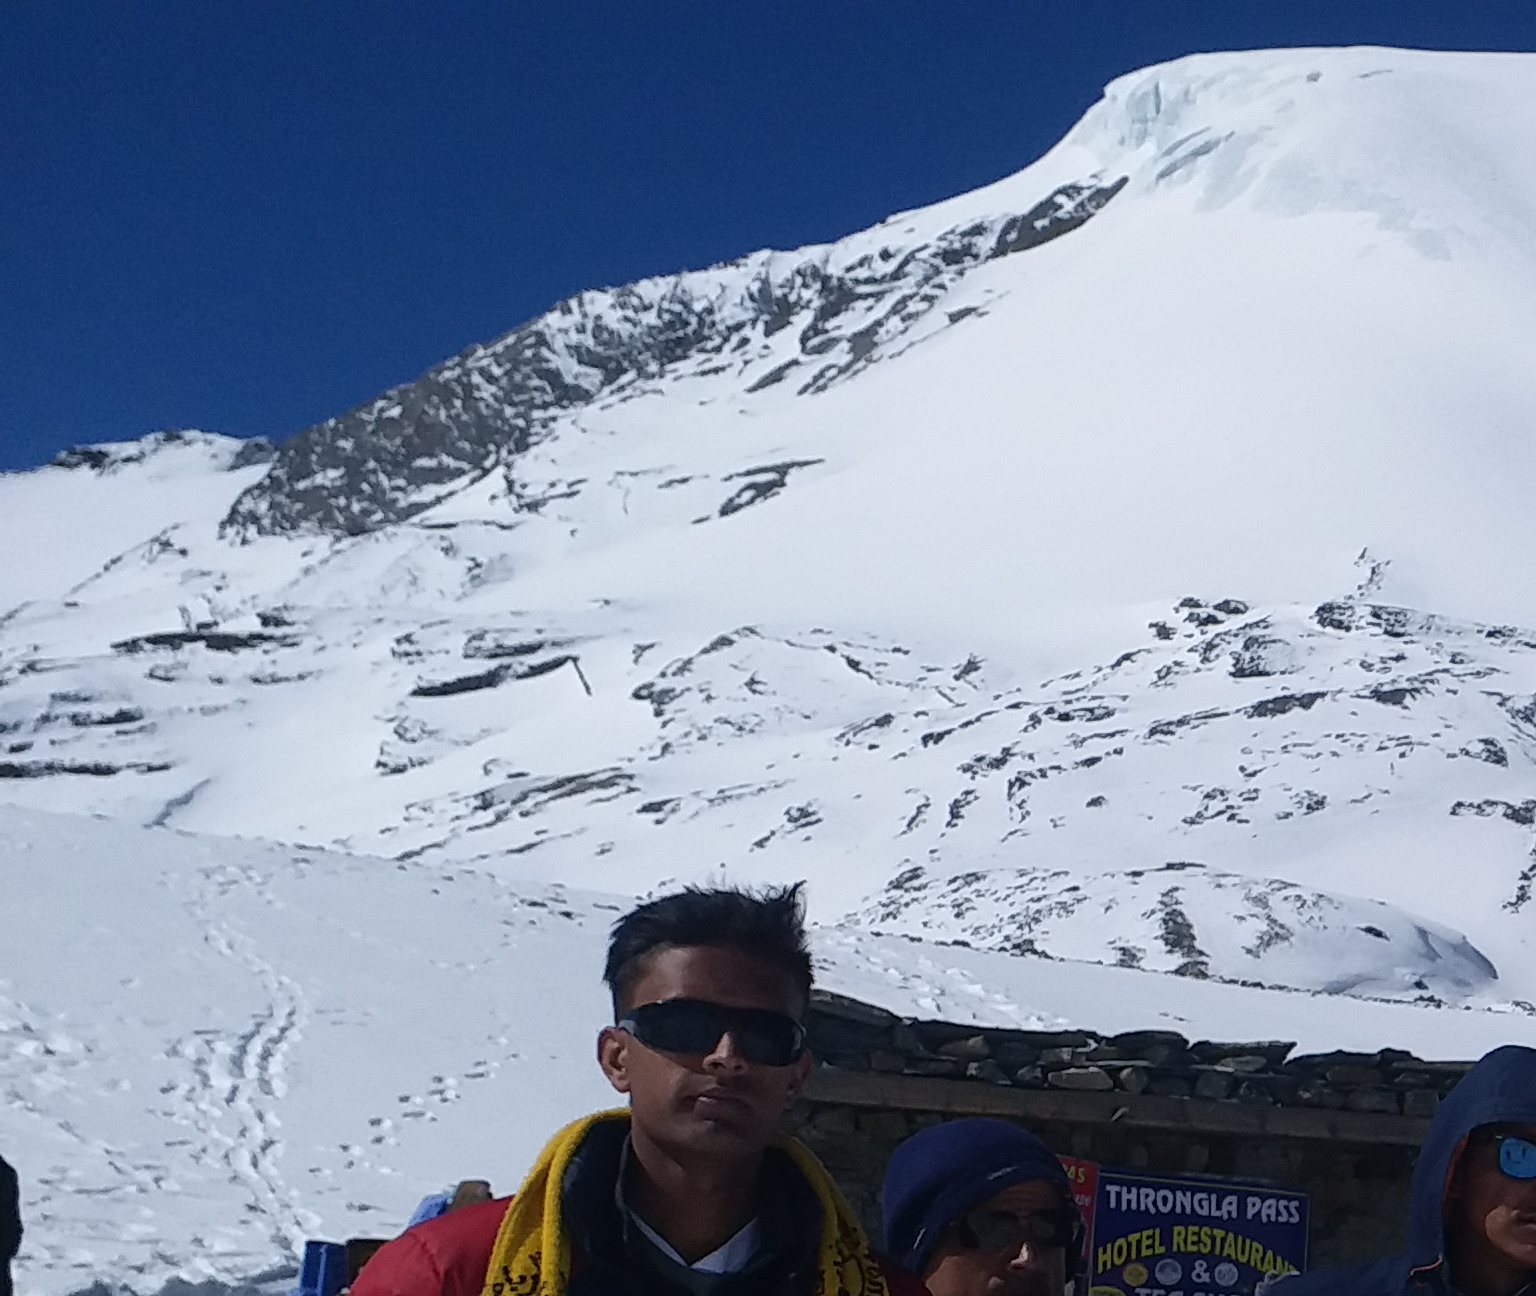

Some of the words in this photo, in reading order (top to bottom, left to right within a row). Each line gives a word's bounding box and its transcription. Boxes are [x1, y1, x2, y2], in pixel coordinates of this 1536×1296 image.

[1105, 1184, 1237, 1221] THRONGLA
[1246, 1196, 1300, 1224] PASS
[1097, 1227, 1165, 1274] HOTEL
[1191, 1259, 1211, 1284] &
